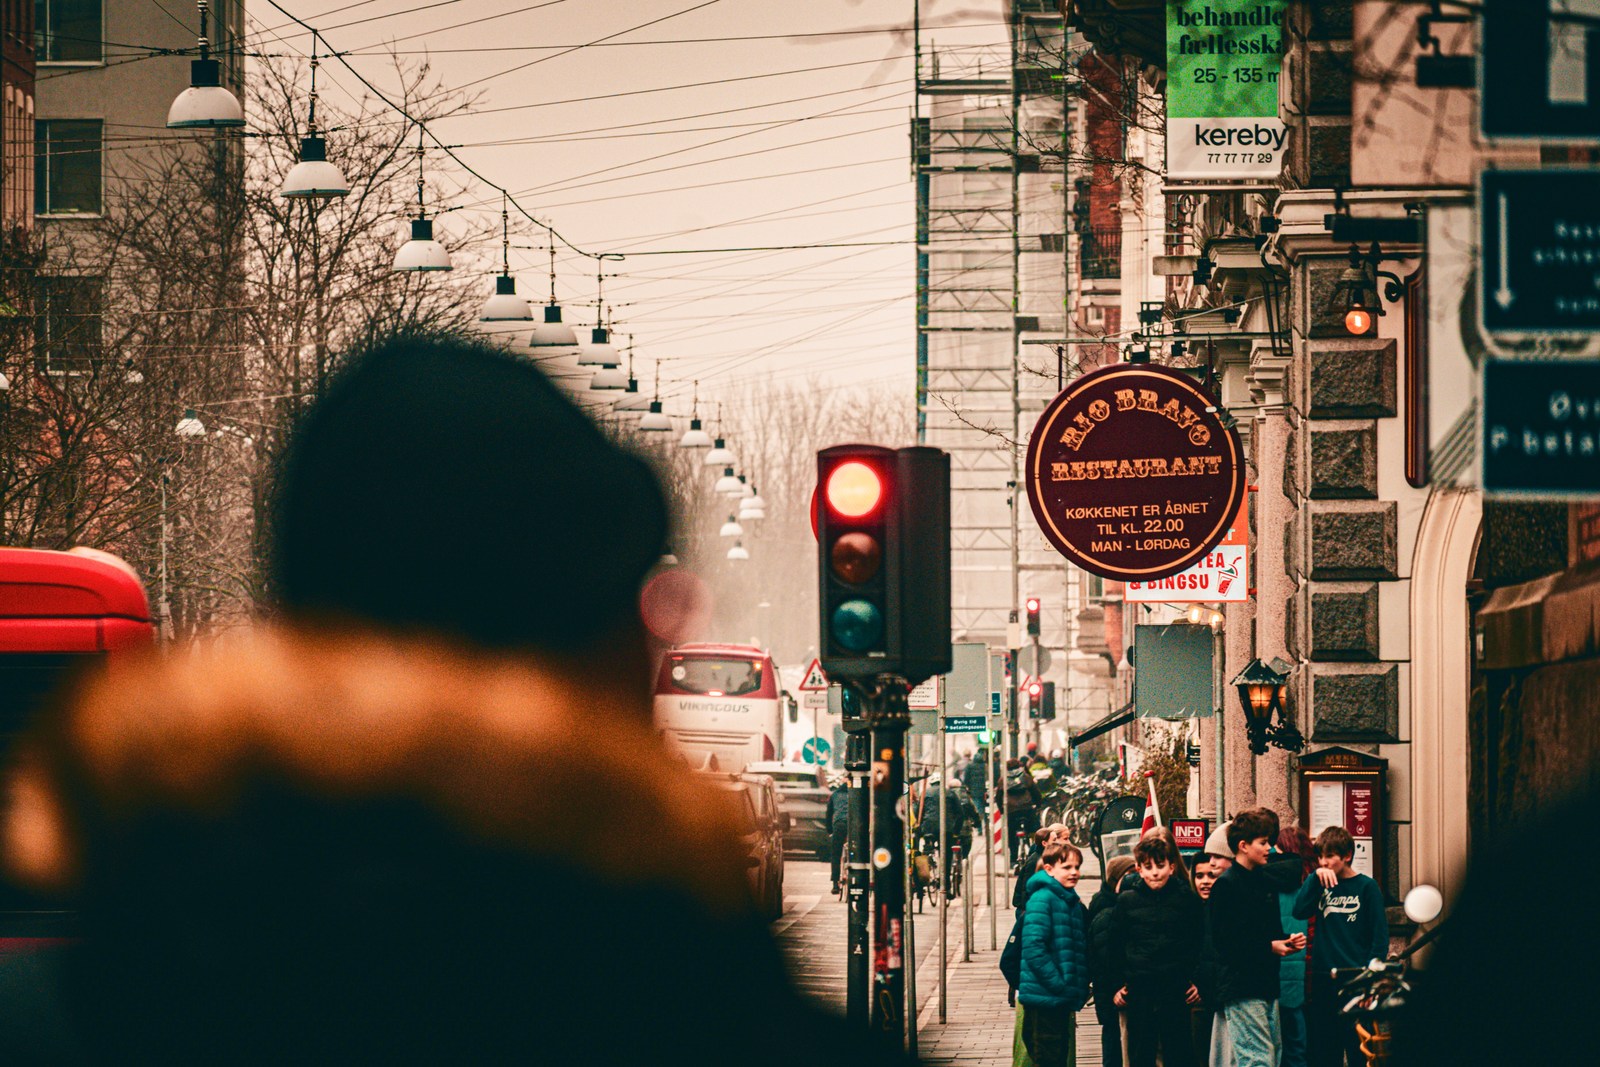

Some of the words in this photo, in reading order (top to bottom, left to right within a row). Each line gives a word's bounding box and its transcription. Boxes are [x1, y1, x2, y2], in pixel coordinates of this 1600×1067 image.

[1194, 68, 1217, 83] 25
[1233, 68, 1263, 83] 135
[1195, 124, 1288, 151] kereby
[1207, 153, 1221, 164] 77
[1224, 153, 1237, 164] 77
[1242, 153, 1255, 164] 77
[1257, 153, 1273, 164] 29
[1059, 399, 1110, 451] RIO
[1114, 388, 1211, 446] BRAVO
[1051, 455, 1222, 481] RESTAURANT
[1066, 506, 1138, 519] KØKKENET
[1142, 505, 1160, 516] ER
[1165, 500, 1209, 515] ÅBNET
[1097, 524, 1117, 535] TIL
[1121, 523, 1142, 534] KL.
[1144, 518, 1184, 533] 22.00
[1091, 540, 1122, 552] MAN
[1135, 538, 1190, 551] LØRDAG
[1148, 574, 1209, 590] BINGSU
[1175, 826, 1203, 837] INFO
